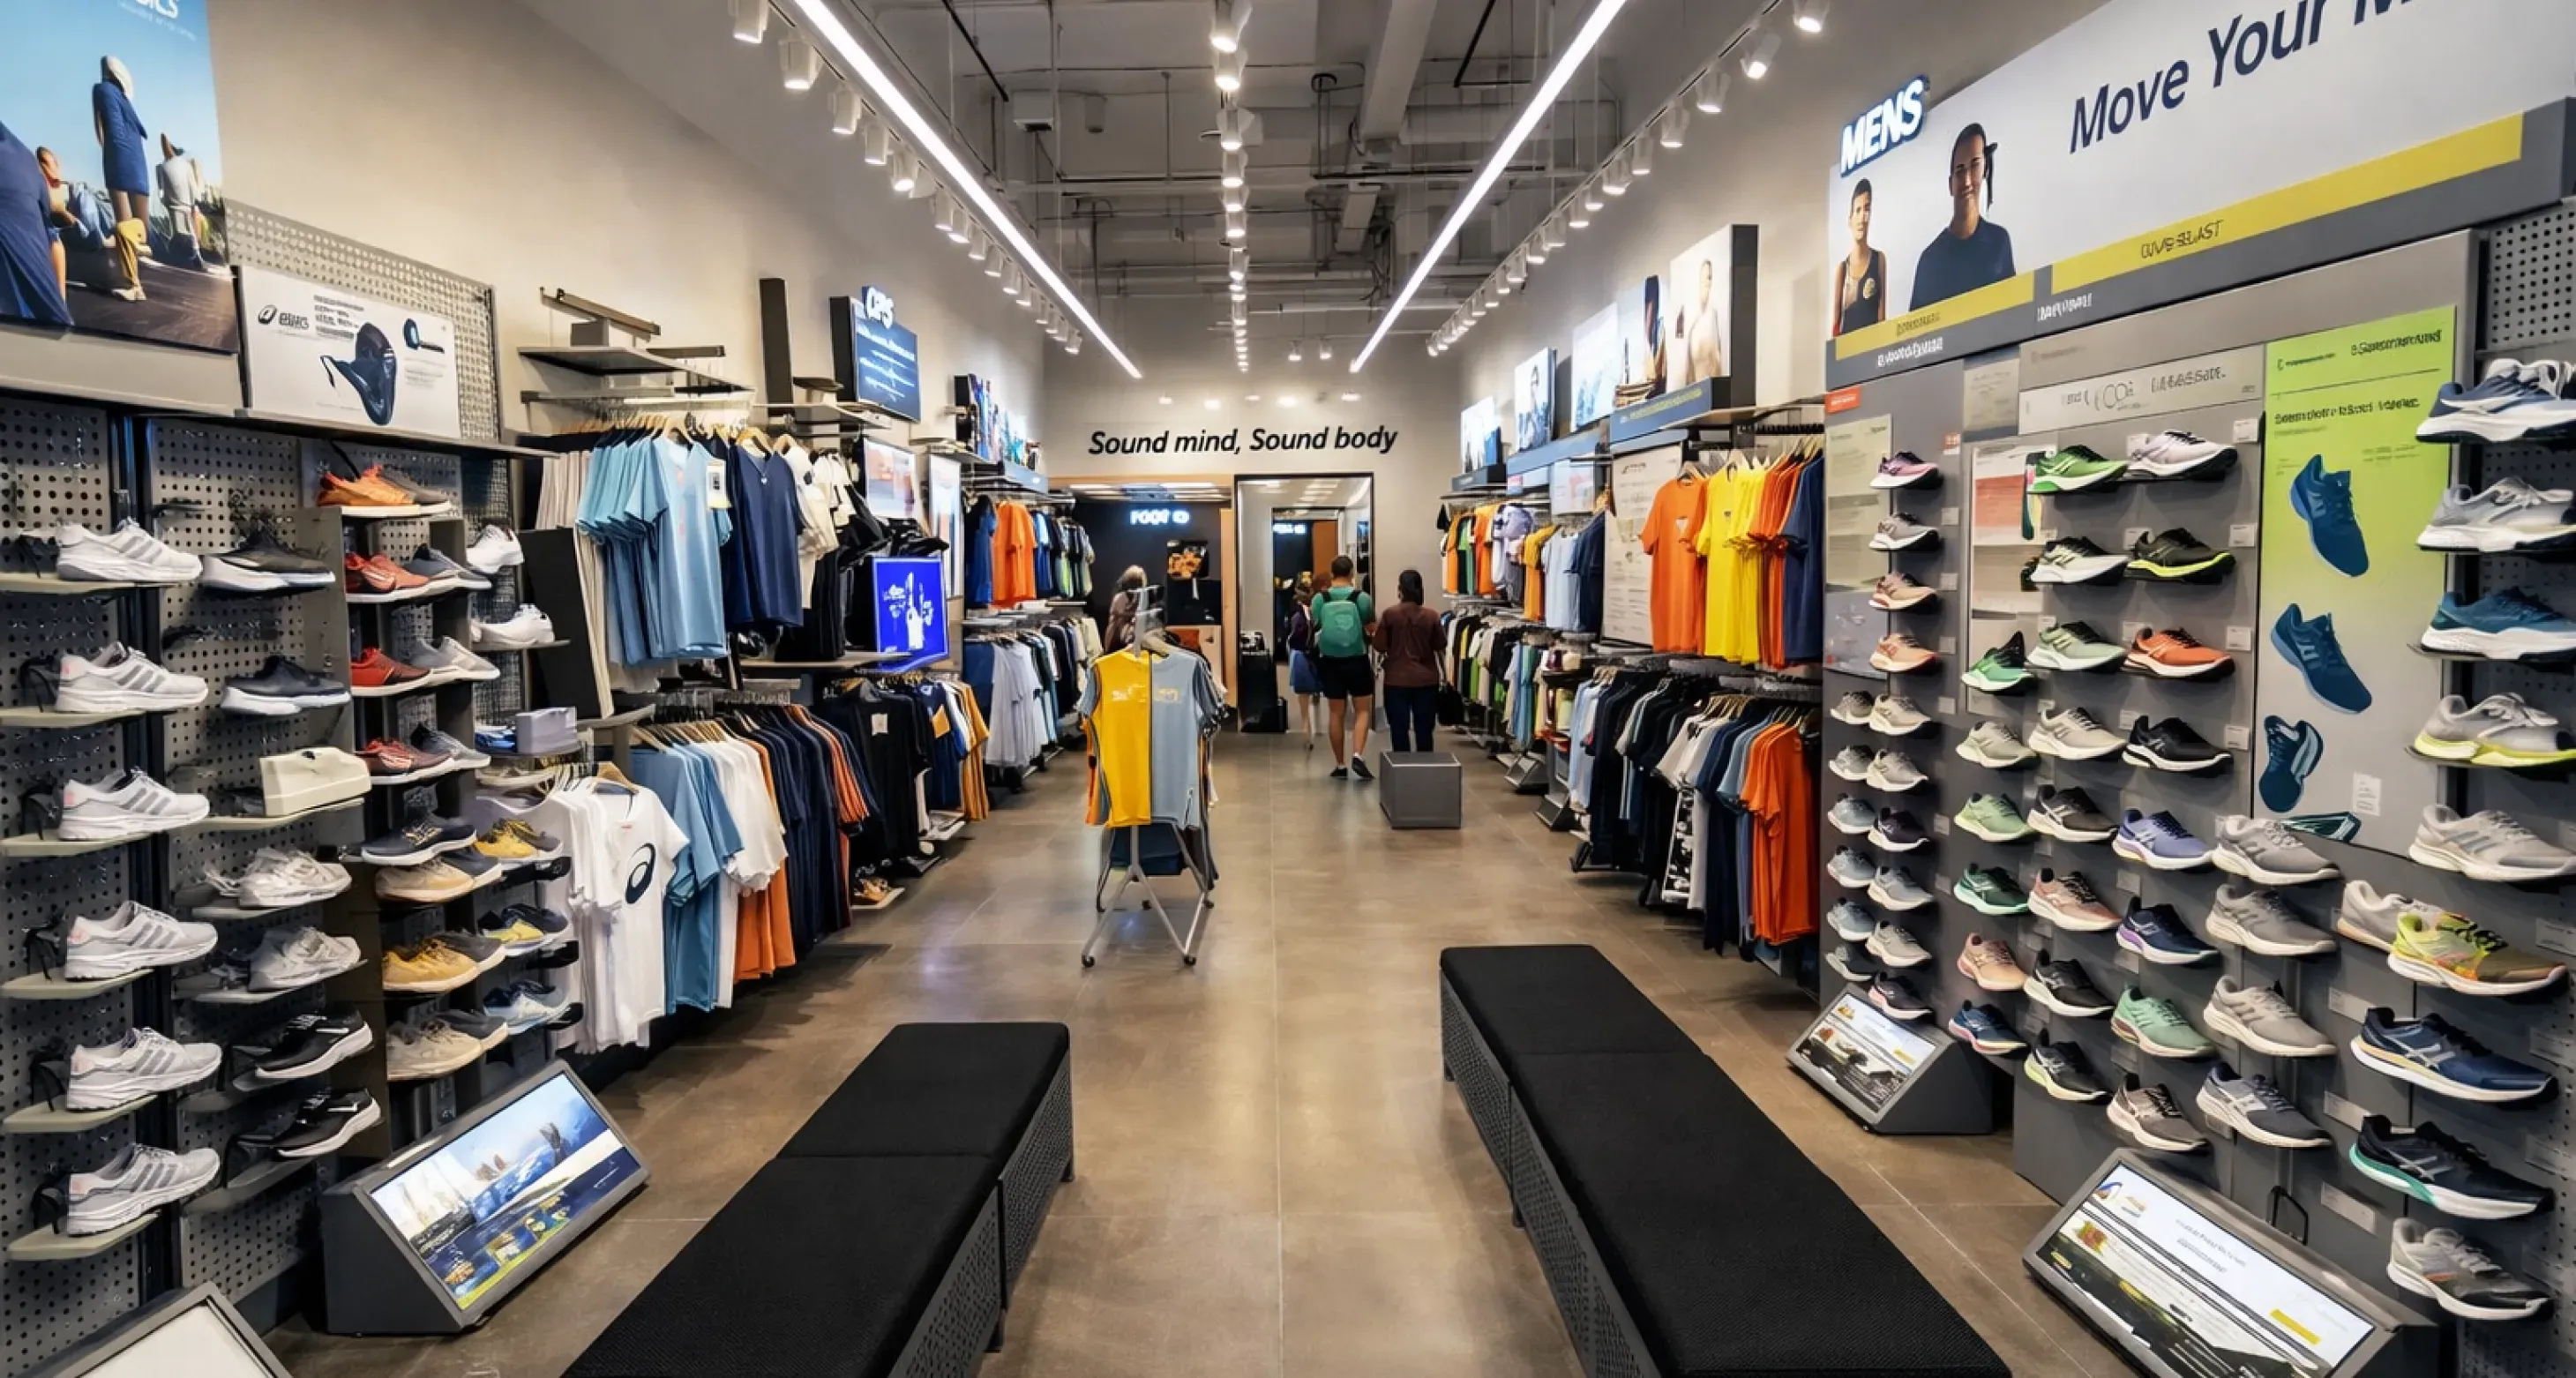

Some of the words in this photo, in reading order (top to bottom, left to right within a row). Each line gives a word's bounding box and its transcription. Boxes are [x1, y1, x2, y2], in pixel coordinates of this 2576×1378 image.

[2070, 59, 2190, 154] Move
[2207, 0, 2327, 88] Your
[1840, 79, 1924, 175] MENS
[1088, 430, 1170, 455] Sound
[1174, 428, 1240, 455] mind,
[1248, 426, 1329, 452] Sound
[1334, 424, 1399, 455] body
